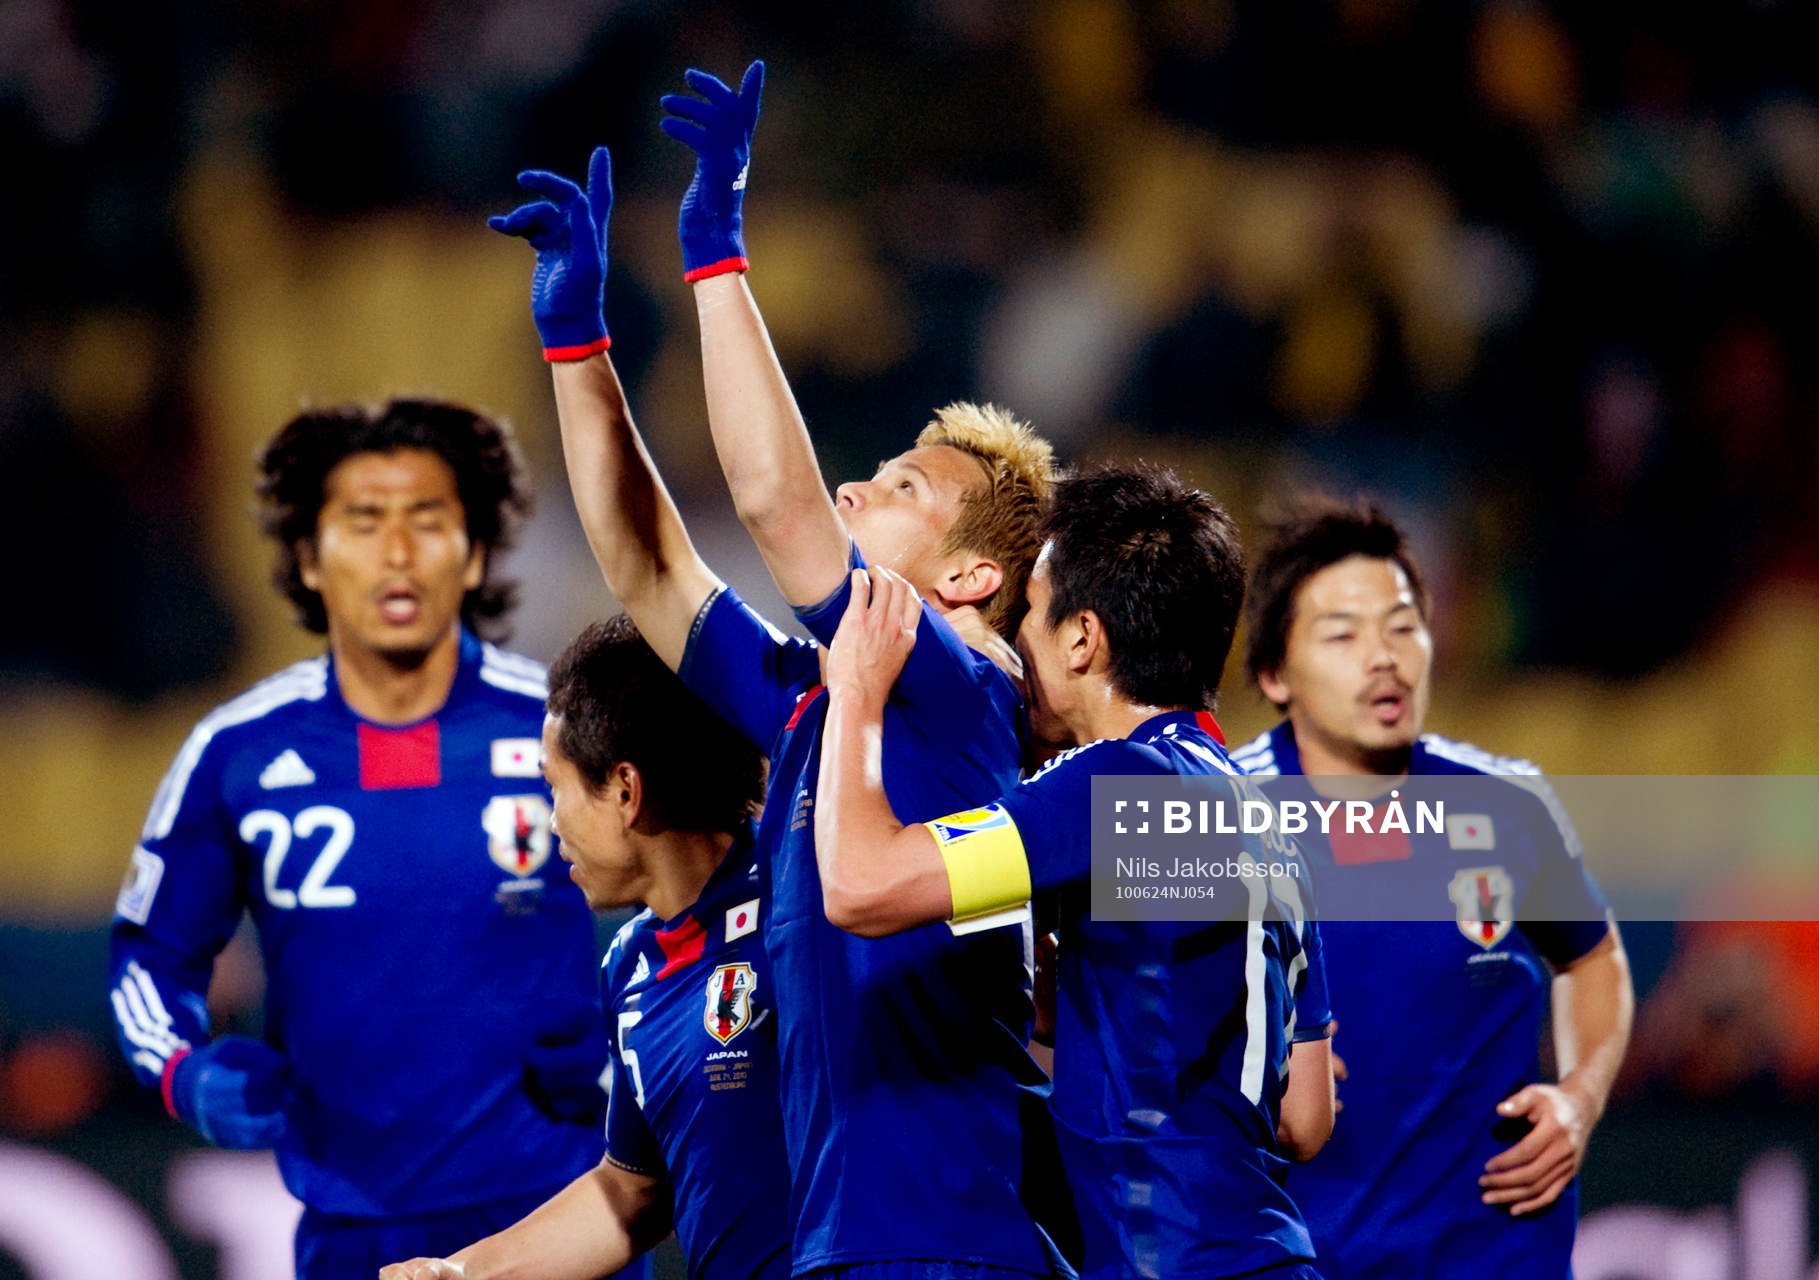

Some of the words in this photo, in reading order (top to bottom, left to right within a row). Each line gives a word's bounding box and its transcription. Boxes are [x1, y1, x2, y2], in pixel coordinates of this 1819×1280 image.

[239, 805, 356, 909] 22
[617, 1011, 646, 1111] 5
[706, 1050, 748, 1061] JAPAN
